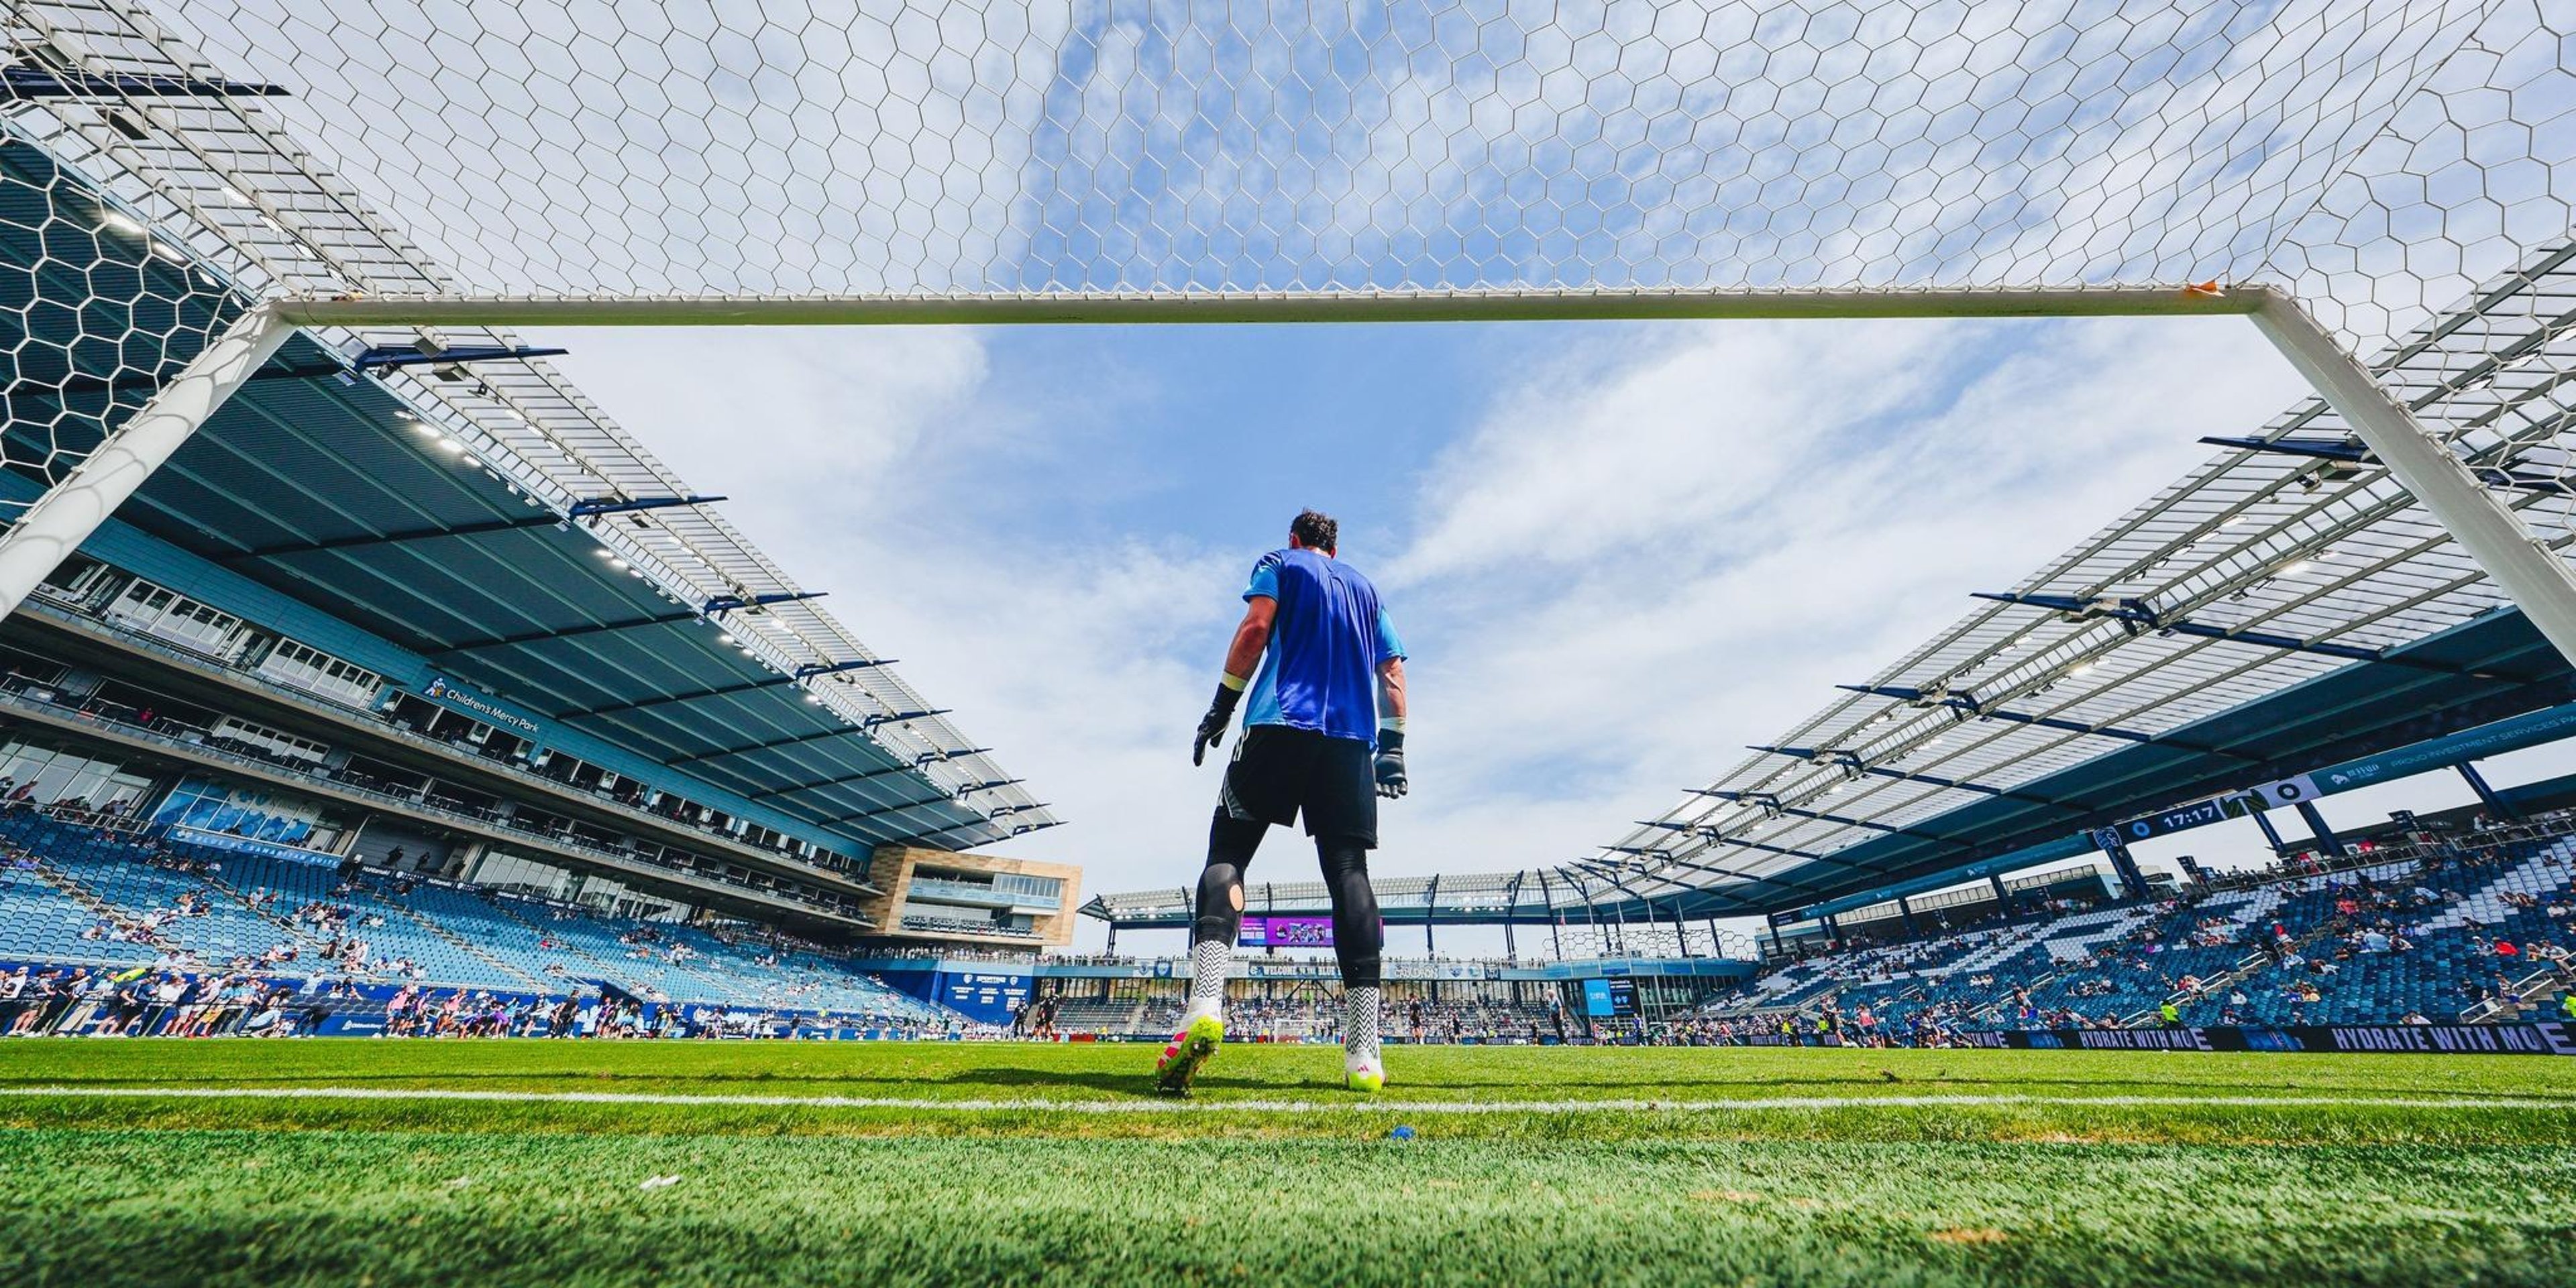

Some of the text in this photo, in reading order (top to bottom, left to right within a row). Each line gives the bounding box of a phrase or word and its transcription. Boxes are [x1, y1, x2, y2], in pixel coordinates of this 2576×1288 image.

[446, 690, 540, 733] Children's Mercy Park
[2428, 736, 2498, 758] INVESTMENT
[2500, 720, 2559, 741] SERVICES
[2163, 806, 2214, 828] 17:17
[2079, 1030, 2137, 1048] HYDRATE
[2132, 1030, 2170, 1048] WITH
[2331, 1027, 2430, 1051] HYDRATE
[2428, 1026, 2498, 1051] WITH
